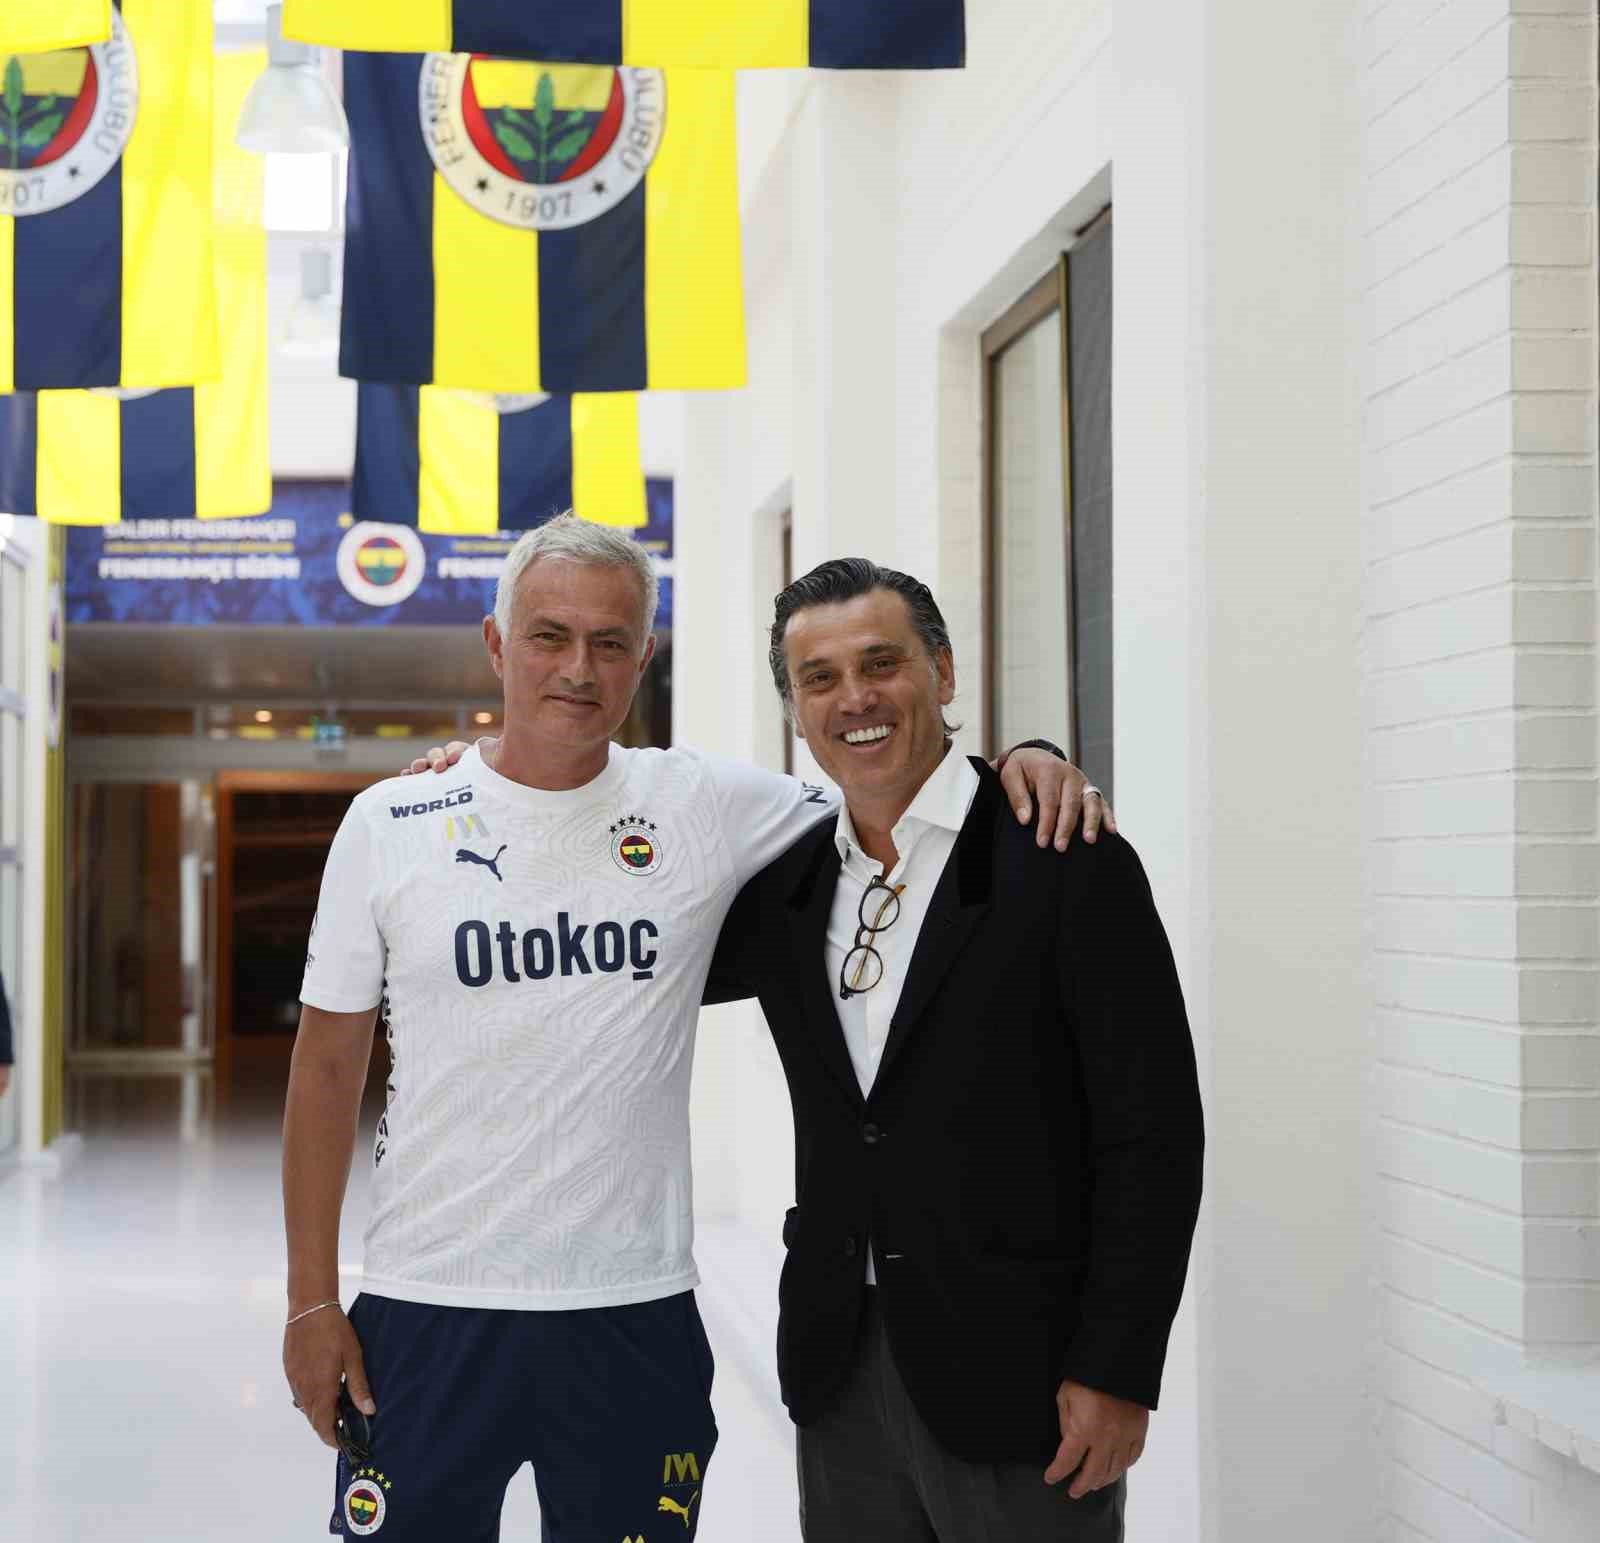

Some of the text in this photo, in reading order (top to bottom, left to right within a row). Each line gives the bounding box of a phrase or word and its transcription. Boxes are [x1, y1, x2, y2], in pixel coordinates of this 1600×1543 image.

[504, 191, 574, 220] 1907
[390, 791, 473, 819] WORLD
[454, 912, 659, 988] Otokoç
